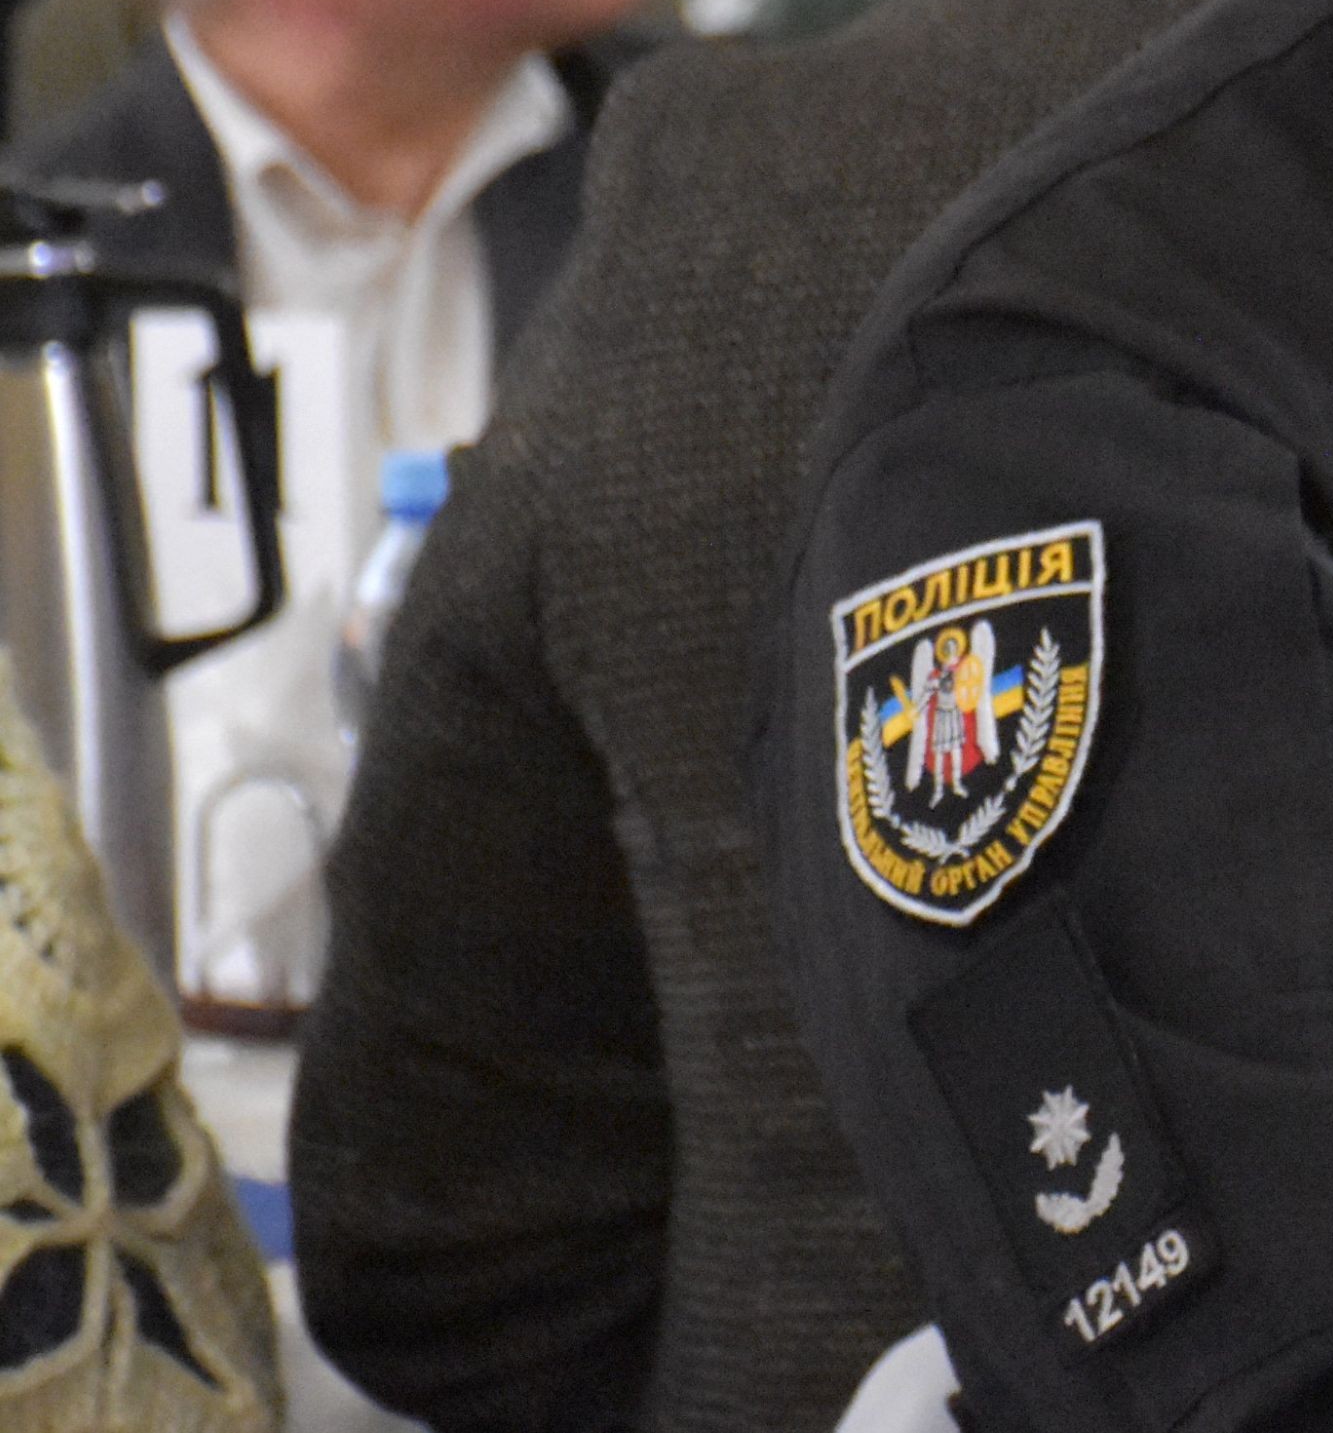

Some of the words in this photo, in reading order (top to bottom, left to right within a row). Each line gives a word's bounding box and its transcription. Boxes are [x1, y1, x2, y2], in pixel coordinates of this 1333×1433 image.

[853, 540, 1074, 651] ПОЛІЦІЯ
[930, 839, 1014, 897] ОРГАН
[1064, 1229, 1190, 1343] 12149
